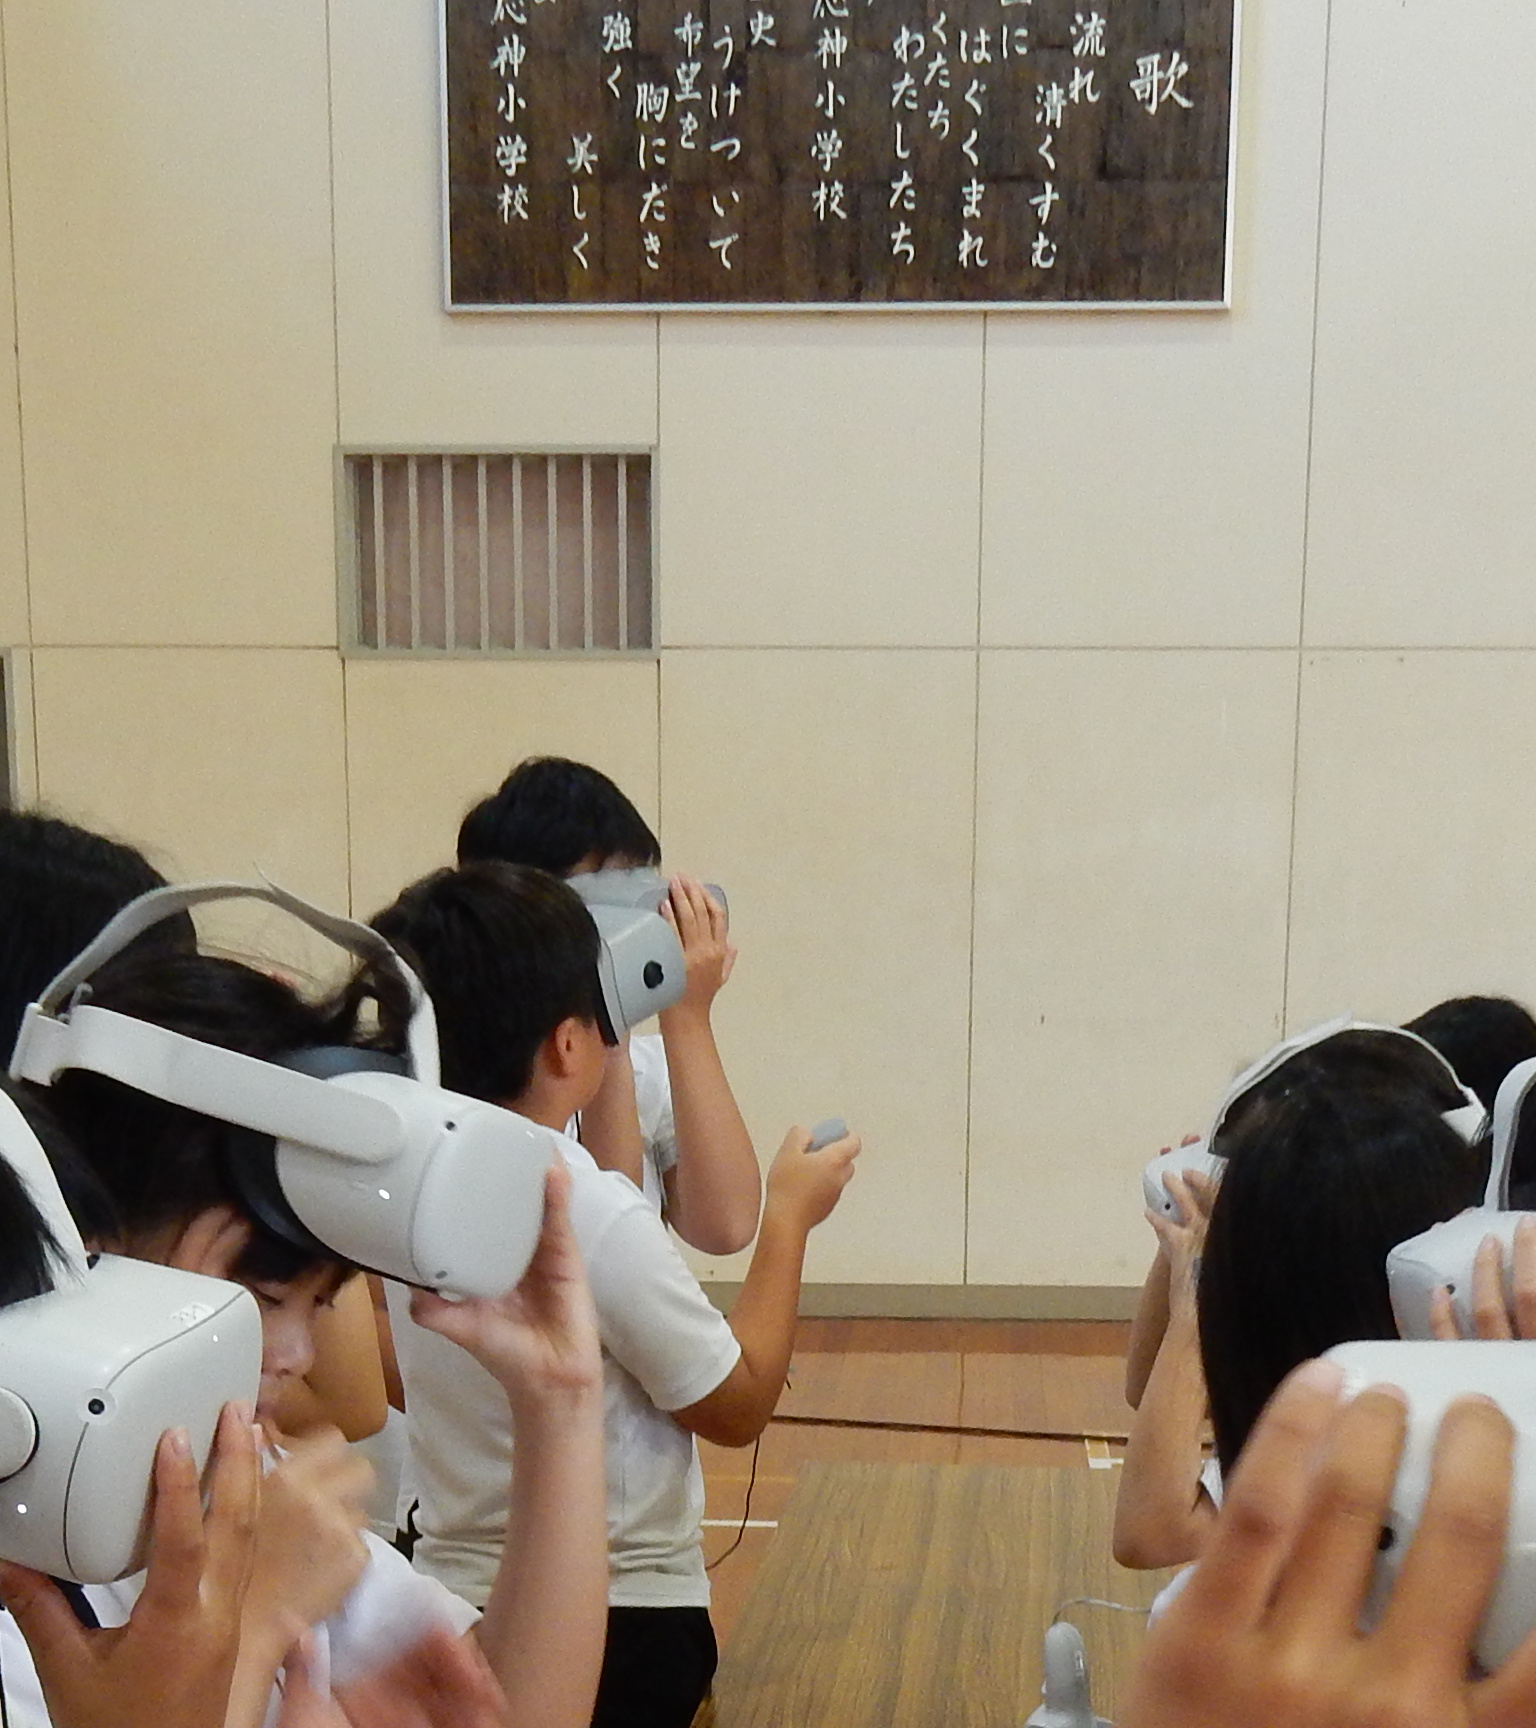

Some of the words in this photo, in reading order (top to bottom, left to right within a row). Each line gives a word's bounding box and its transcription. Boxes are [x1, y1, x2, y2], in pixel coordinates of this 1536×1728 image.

[602, 11, 633, 99] 強く
[674, 12, 704, 150] 希望を
[924, 11, 951, 139] くたち
[1000, 0, 1032, 59] に
[1068, 11, 1107, 105] 流れ
[1129, 51, 1194, 116] 歌
[635, 82, 670, 270] 胸にだき
[709, 24, 742, 270] うけついで
[889, 25, 925, 265] わたしたち
[958, 27, 992, 268] はぐくまれ
[1029, 81, 1068, 269] 清くすむ
